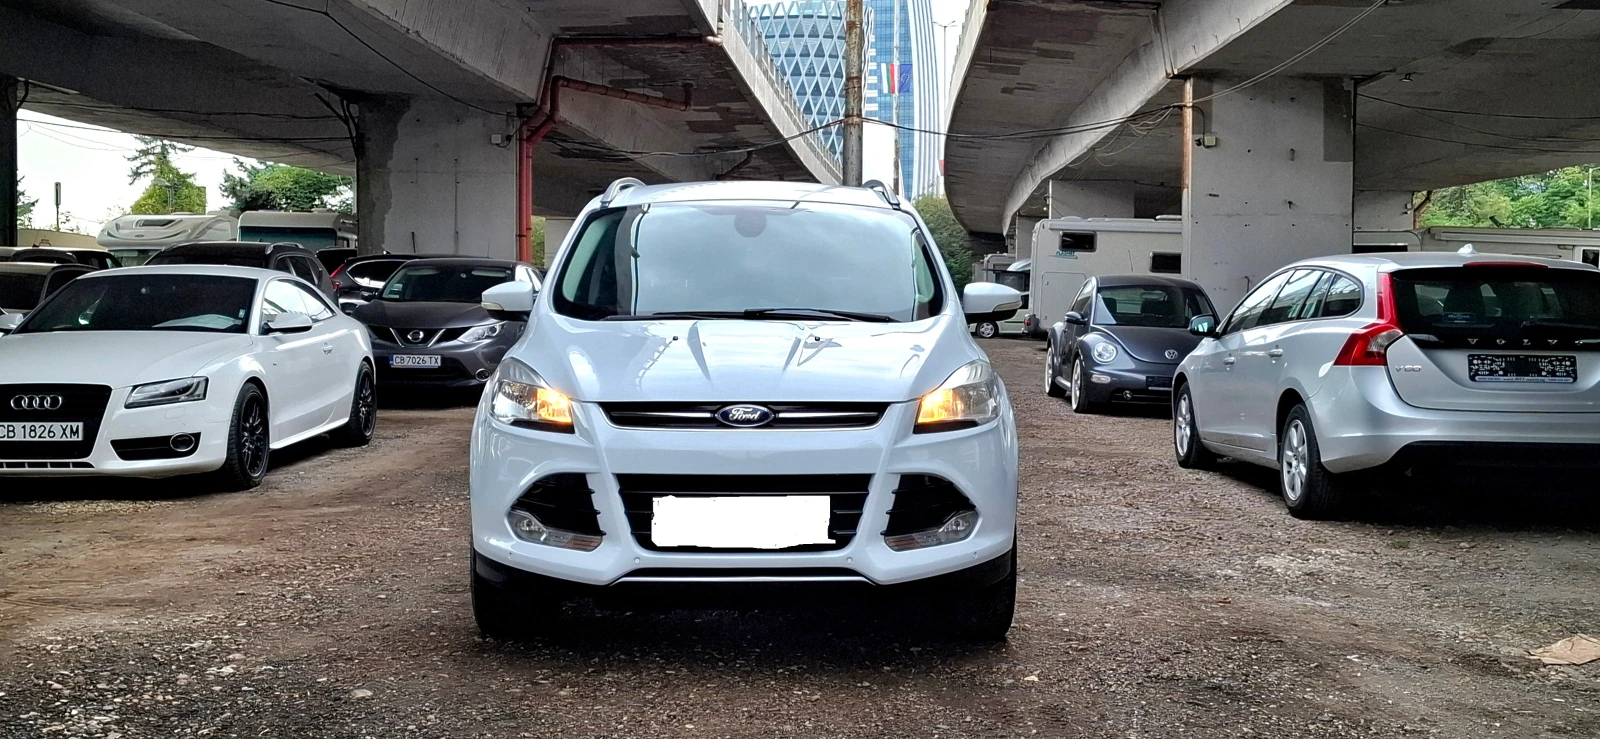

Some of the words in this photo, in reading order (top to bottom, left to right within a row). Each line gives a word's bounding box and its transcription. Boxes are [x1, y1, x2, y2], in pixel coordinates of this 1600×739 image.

[394, 355, 404, 365] CB
[406, 356, 427, 365] 7026
[428, 356, 439, 365] TX
[728, 407, 761, 421] Ford
[21, 424, 56, 439] 1826
[60, 424, 80, 439] XM
